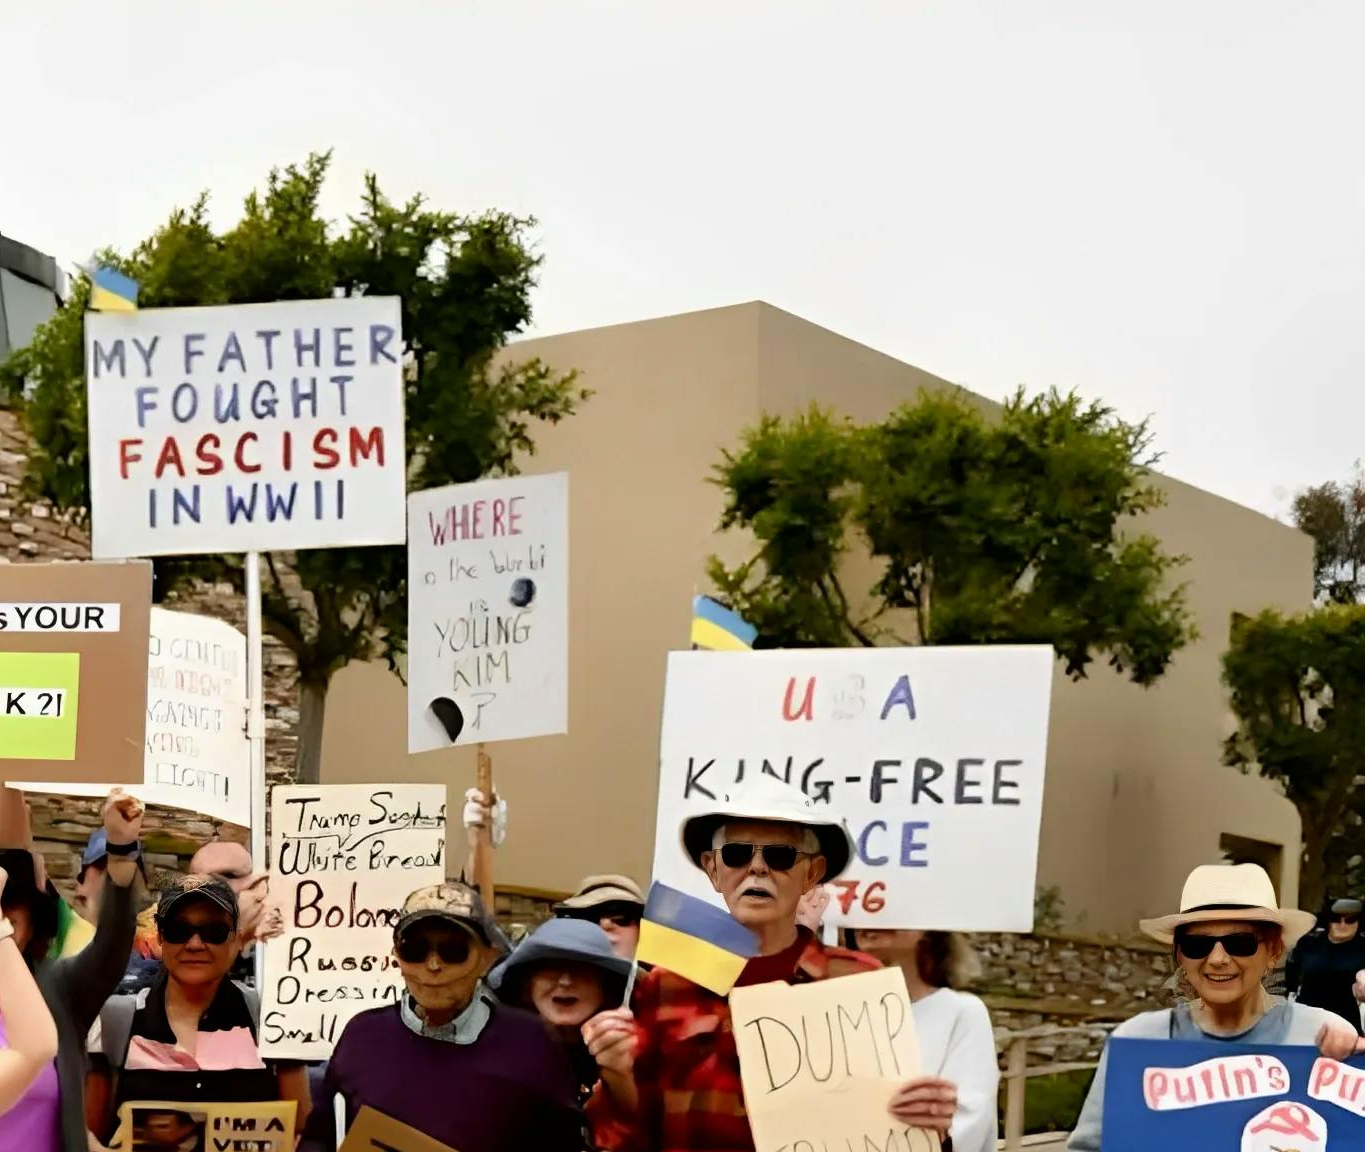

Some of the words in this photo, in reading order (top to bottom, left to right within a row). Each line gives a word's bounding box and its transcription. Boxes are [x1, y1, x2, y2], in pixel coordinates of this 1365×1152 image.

[93, 335, 160, 379] MY
[183, 324, 397, 375] FATHER
[135, 375, 354, 428] FOUGHT
[119, 426, 385, 480] FASCISM
[148, 485, 202, 529] IN
[226, 479, 345, 526] WWII
[429, 496, 525, 546] WHERE
[14, 606, 105, 630] YOUR
[434, 610, 533, 657] YOUNG
[452, 650, 512, 691] KIM
[278, 839, 357, 875] White
[744, 992, 905, 1095] DUMP
[1147, 1056, 1286, 1110] Putin's
